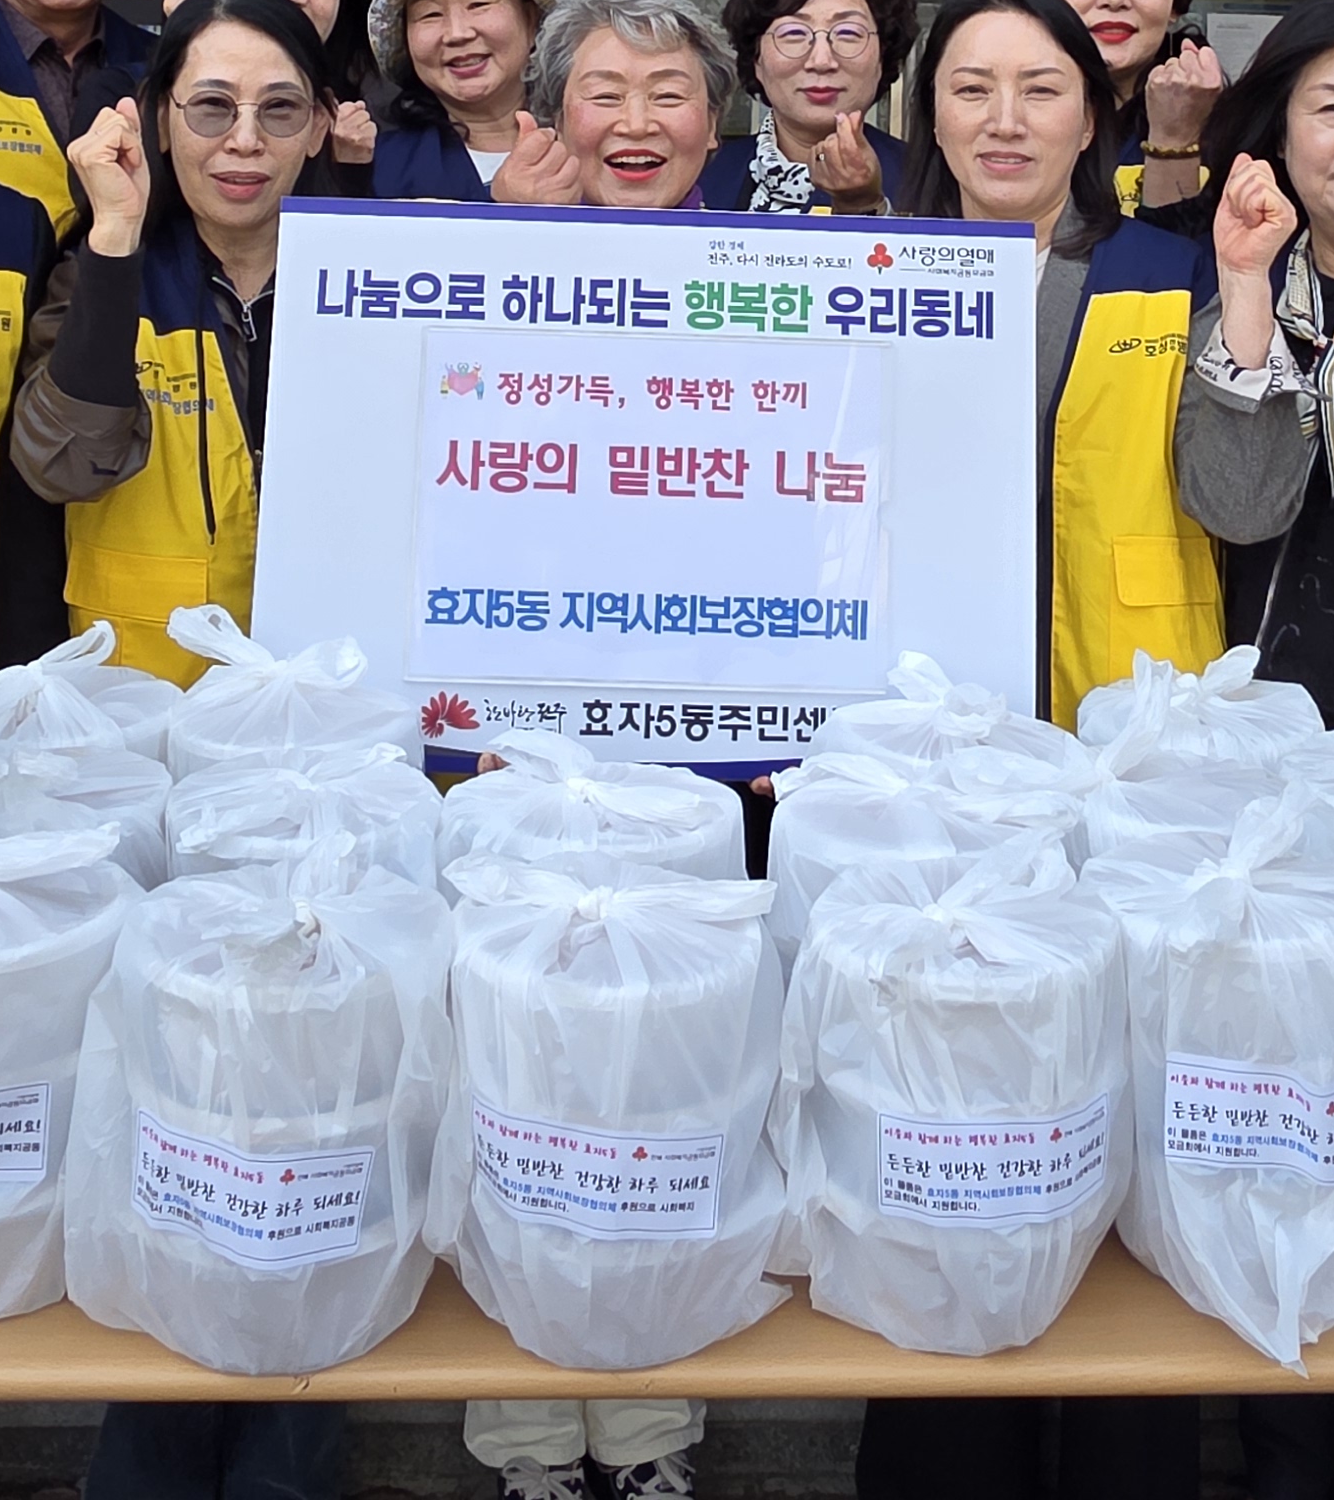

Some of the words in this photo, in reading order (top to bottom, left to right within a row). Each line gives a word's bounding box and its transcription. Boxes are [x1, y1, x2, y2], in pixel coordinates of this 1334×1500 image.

[737, 254, 759, 267] 다시
[764, 255, 808, 268] 전라도의
[813, 256, 852, 269] 수도로!
[898, 246, 995, 268] 사랑의열매
[316, 268, 487, 322] 나눔으로
[502, 276, 671, 327] 하나되는
[684, 280, 813, 334] 행복한
[825, 286, 995, 340] 우리동네
[496, 372, 628, 409] 정성가득,
[645, 375, 735, 413] 행복한
[752, 380, 809, 413] 한끼
[435, 439, 579, 496] 사랑의
[608, 446, 749, 501] 밑반찬
[774, 452, 868, 504] 나눔
[424, 586, 550, 634] 효자5동
[560, 590, 869, 642] 지역사회보장협의체
[579, 699, 836, 743] 효자5동주민센
[1172, 1101, 1217, 1123] 든든한
[1225, 1109, 1269, 1127] 밑반찬
[1279, 1113, 1320, 1145] 건강한
[517, 1157, 565, 1180] 밑반찬
[575, 1170, 622, 1194] 건강한
[629, 1177, 659, 1194] 하루
[887, 1154, 931, 1178] 든든한
[939, 1162, 987, 1181] 밑반찬
[997, 1159, 1042, 1179] 건강한
[1049, 1153, 1072, 1173] 하루
[1078, 1132, 1104, 1159] 되세요!
[225, 1192, 267, 1219] 건강한
[275, 1198, 304, 1217] 하루
[313, 1190, 360, 1210] 되세요!
